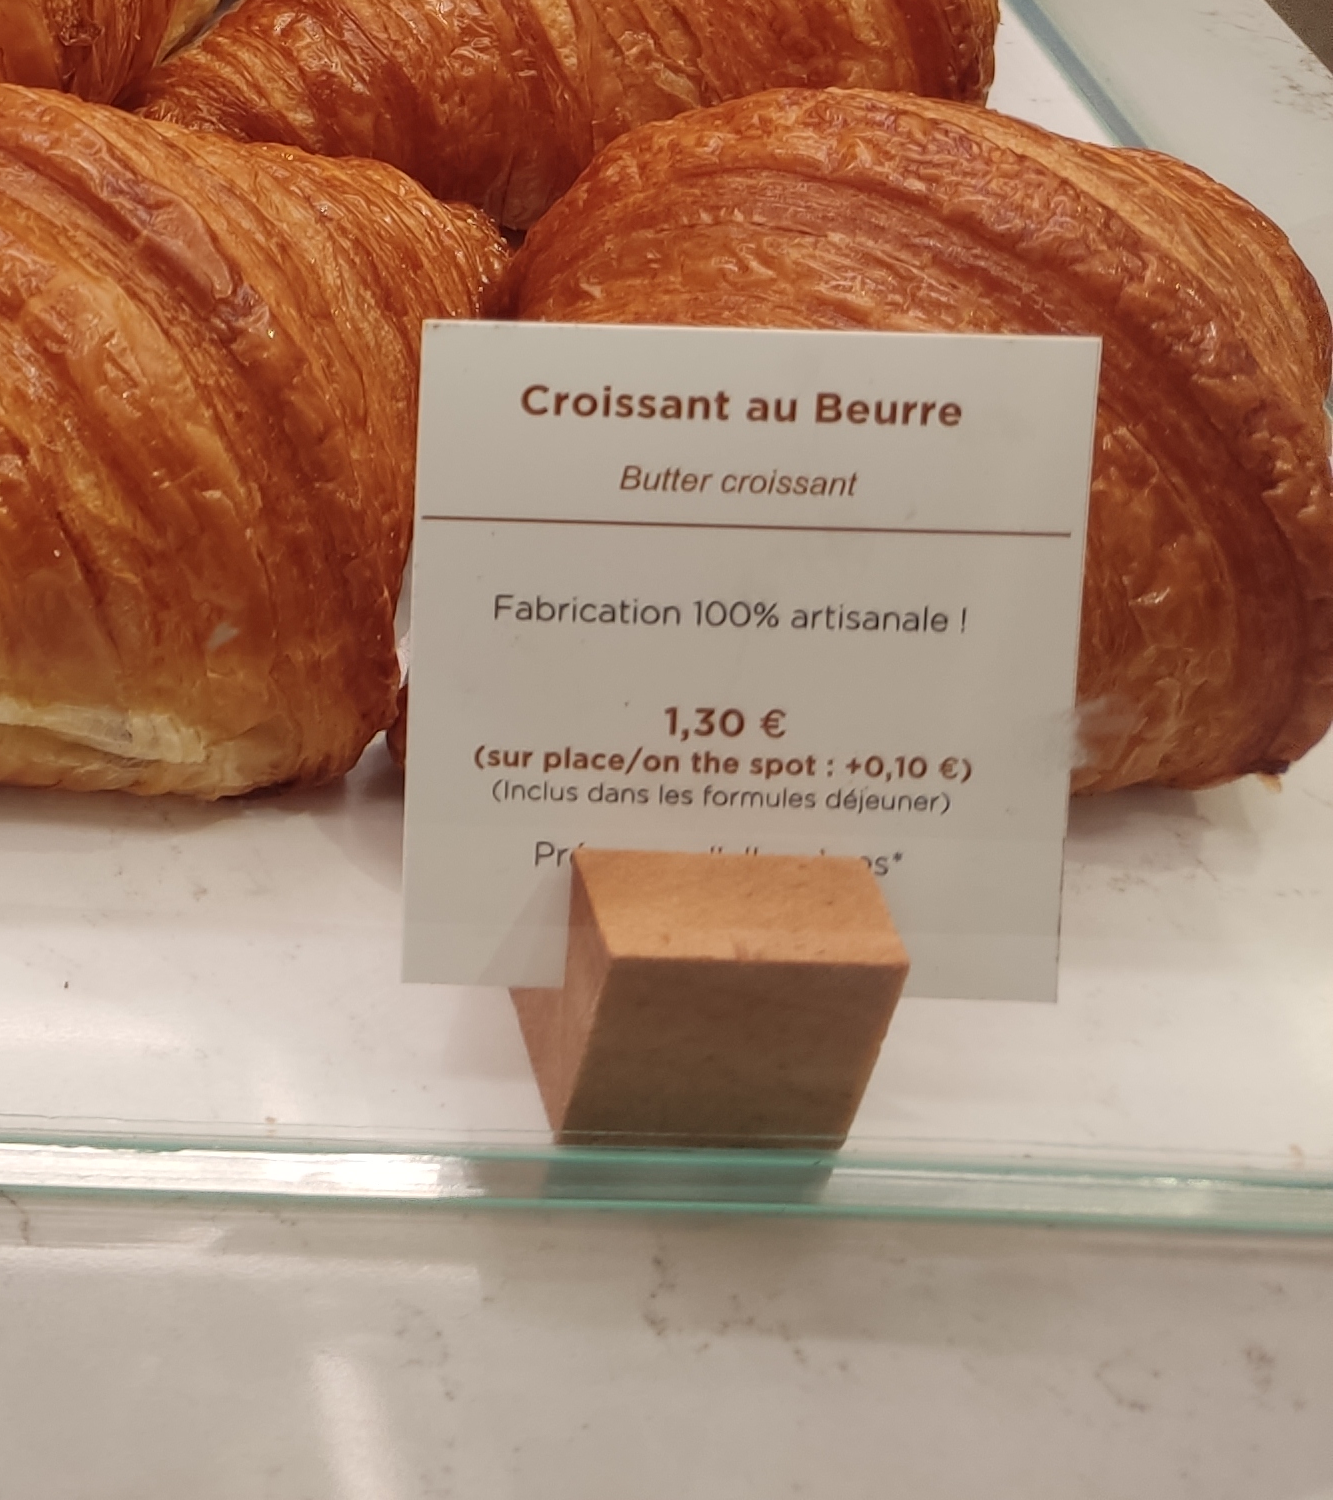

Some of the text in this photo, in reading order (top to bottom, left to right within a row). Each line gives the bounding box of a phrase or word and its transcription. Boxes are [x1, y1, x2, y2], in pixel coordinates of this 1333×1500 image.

[520, 383, 963, 428] Croissant au Beurre
[619, 464, 858, 497] Butter croissant
[493, 593, 967, 634] Fabrication 100% artisanale !
[664, 706, 787, 742] 1,30 €
[473, 744, 973, 784] (sur place/on the spot : +0,10 €)
[587, 782, 650, 805] dans
[658, 784, 694, 806] les
[703, 784, 817, 809] formules
[825, 788, 951, 816] déjeuner)
